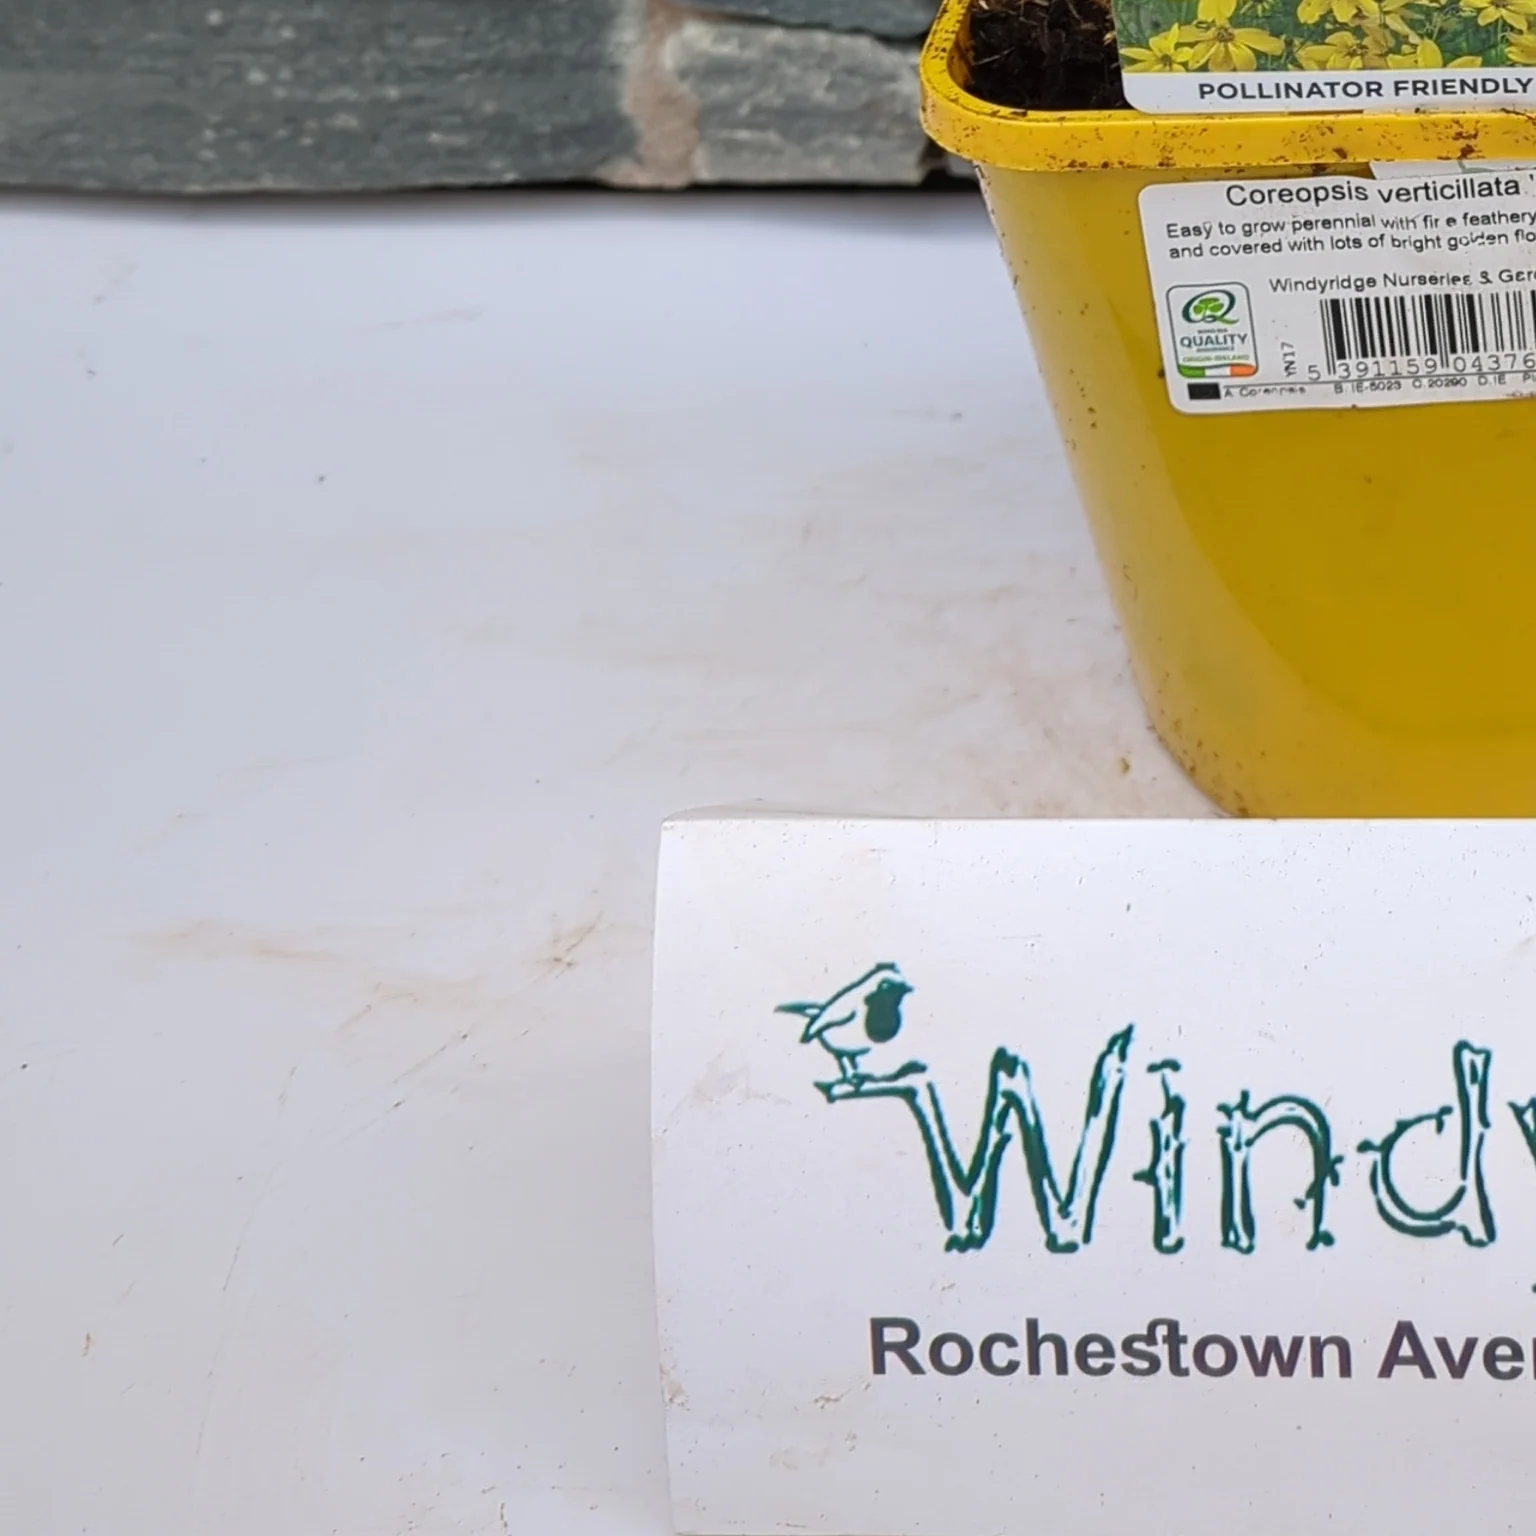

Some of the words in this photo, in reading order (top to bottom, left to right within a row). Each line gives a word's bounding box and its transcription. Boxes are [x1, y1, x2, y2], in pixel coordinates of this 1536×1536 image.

[1198, 80, 1385, 100] POLLINATOR
[1392, 77, 1534, 97] FRIENDLY
[1226, 179, 1369, 206] Coreopsis
[1377, 176, 1520, 203] verticillata
[1166, 220, 1212, 240] Easy
[1218, 221, 1237, 235] to
[1241, 221, 1286, 239] grow
[1291, 214, 1375, 236] perennial
[1380, 216, 1417, 230] with
[1169, 243, 1203, 260] and
[1209, 238, 1283, 257] covered
[1287, 236, 1324, 252] with
[1329, 235, 1363, 251] lots
[1367, 233, 1385, 248] of
[1390, 234, 1441, 253] bright
[1268, 274, 1377, 293] Windyridge
[1383, 271, 1472, 288] Nurseries
[1180, 333, 1249, 349] QUALITY
[869, 1316, 1353, 1380] Rochestown
